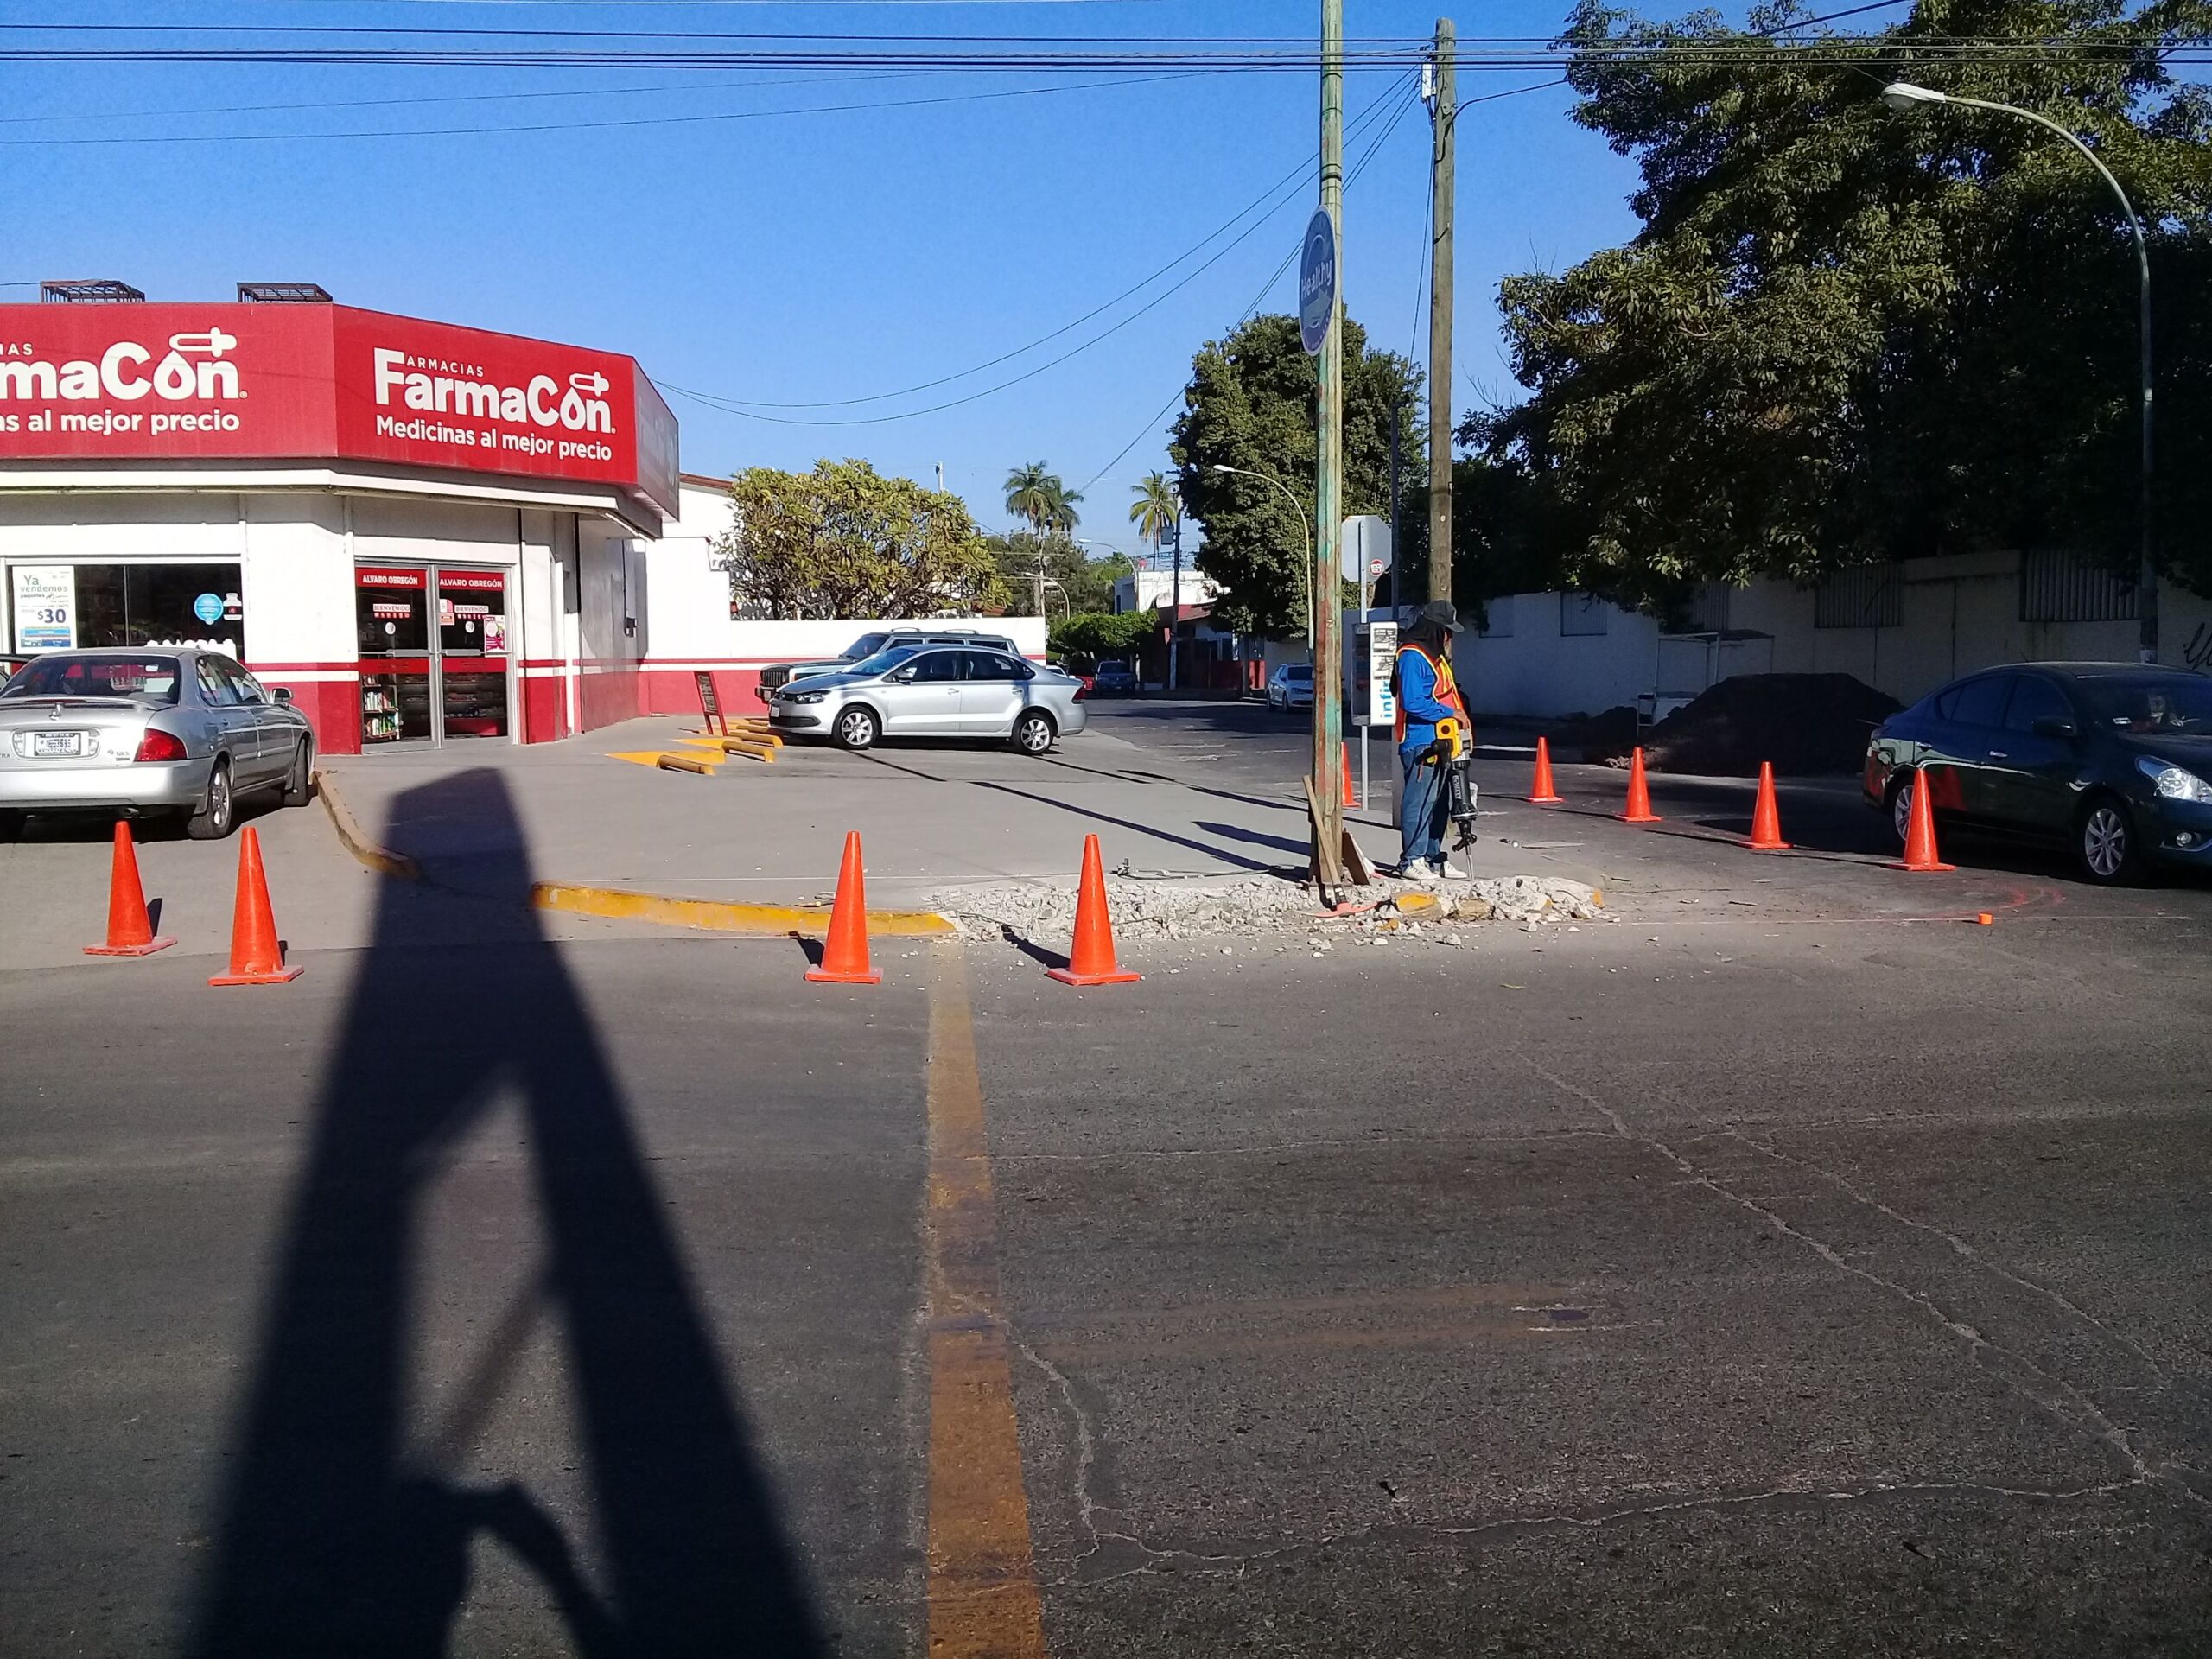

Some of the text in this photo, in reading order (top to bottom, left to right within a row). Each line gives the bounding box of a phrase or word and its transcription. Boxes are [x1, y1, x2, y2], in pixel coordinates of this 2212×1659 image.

[1300, 259, 1332, 302] Healthy
[28, 409, 51, 432] al
[60, 409, 143, 436] mejor
[150, 409, 240, 436] precio
[376, 414, 613, 461] Medicinas al mejor precio
[23, 575, 39, 586] Ya
[362, 575, 418, 585] ALVARO OBREGÓN
[439, 578, 503, 588] ALVARO OBREGÓN
[37, 608, 67, 624] $30
